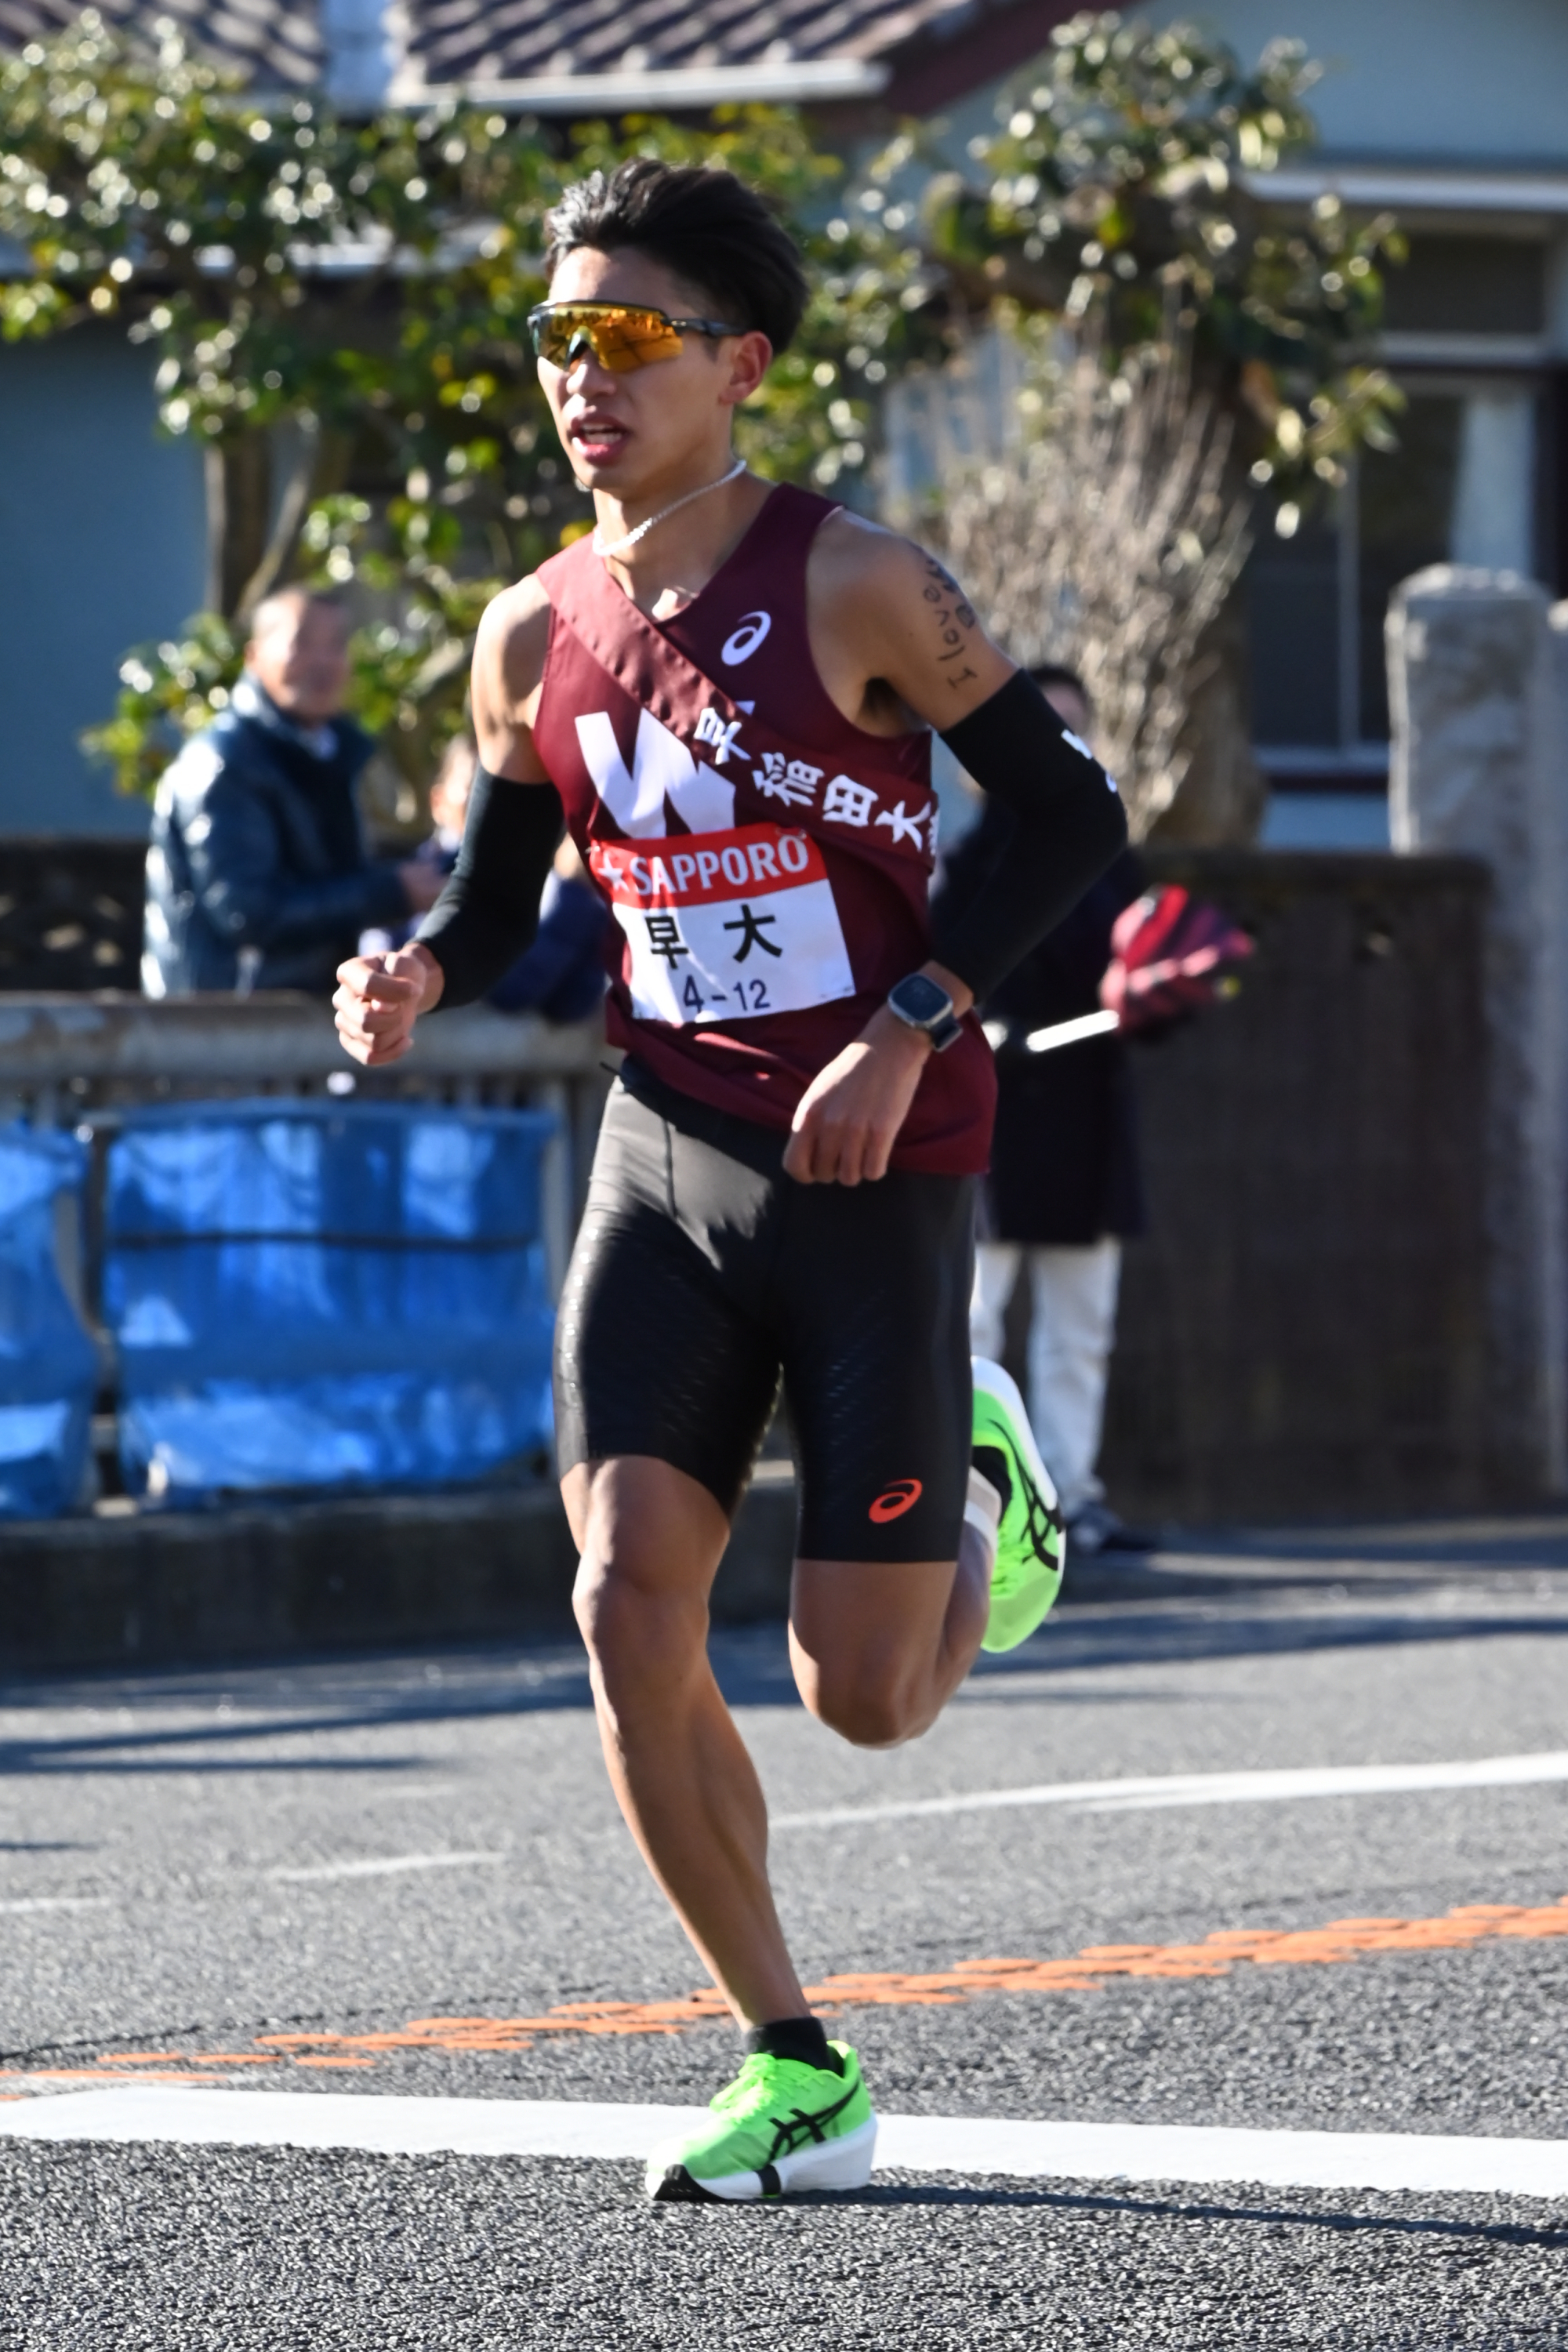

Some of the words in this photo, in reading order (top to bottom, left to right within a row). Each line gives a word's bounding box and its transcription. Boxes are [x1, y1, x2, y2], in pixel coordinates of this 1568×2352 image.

[575, 700, 756, 839] W
[629, 834, 809, 896] SAPPORO
[683, 975, 771, 1013] 4-12
